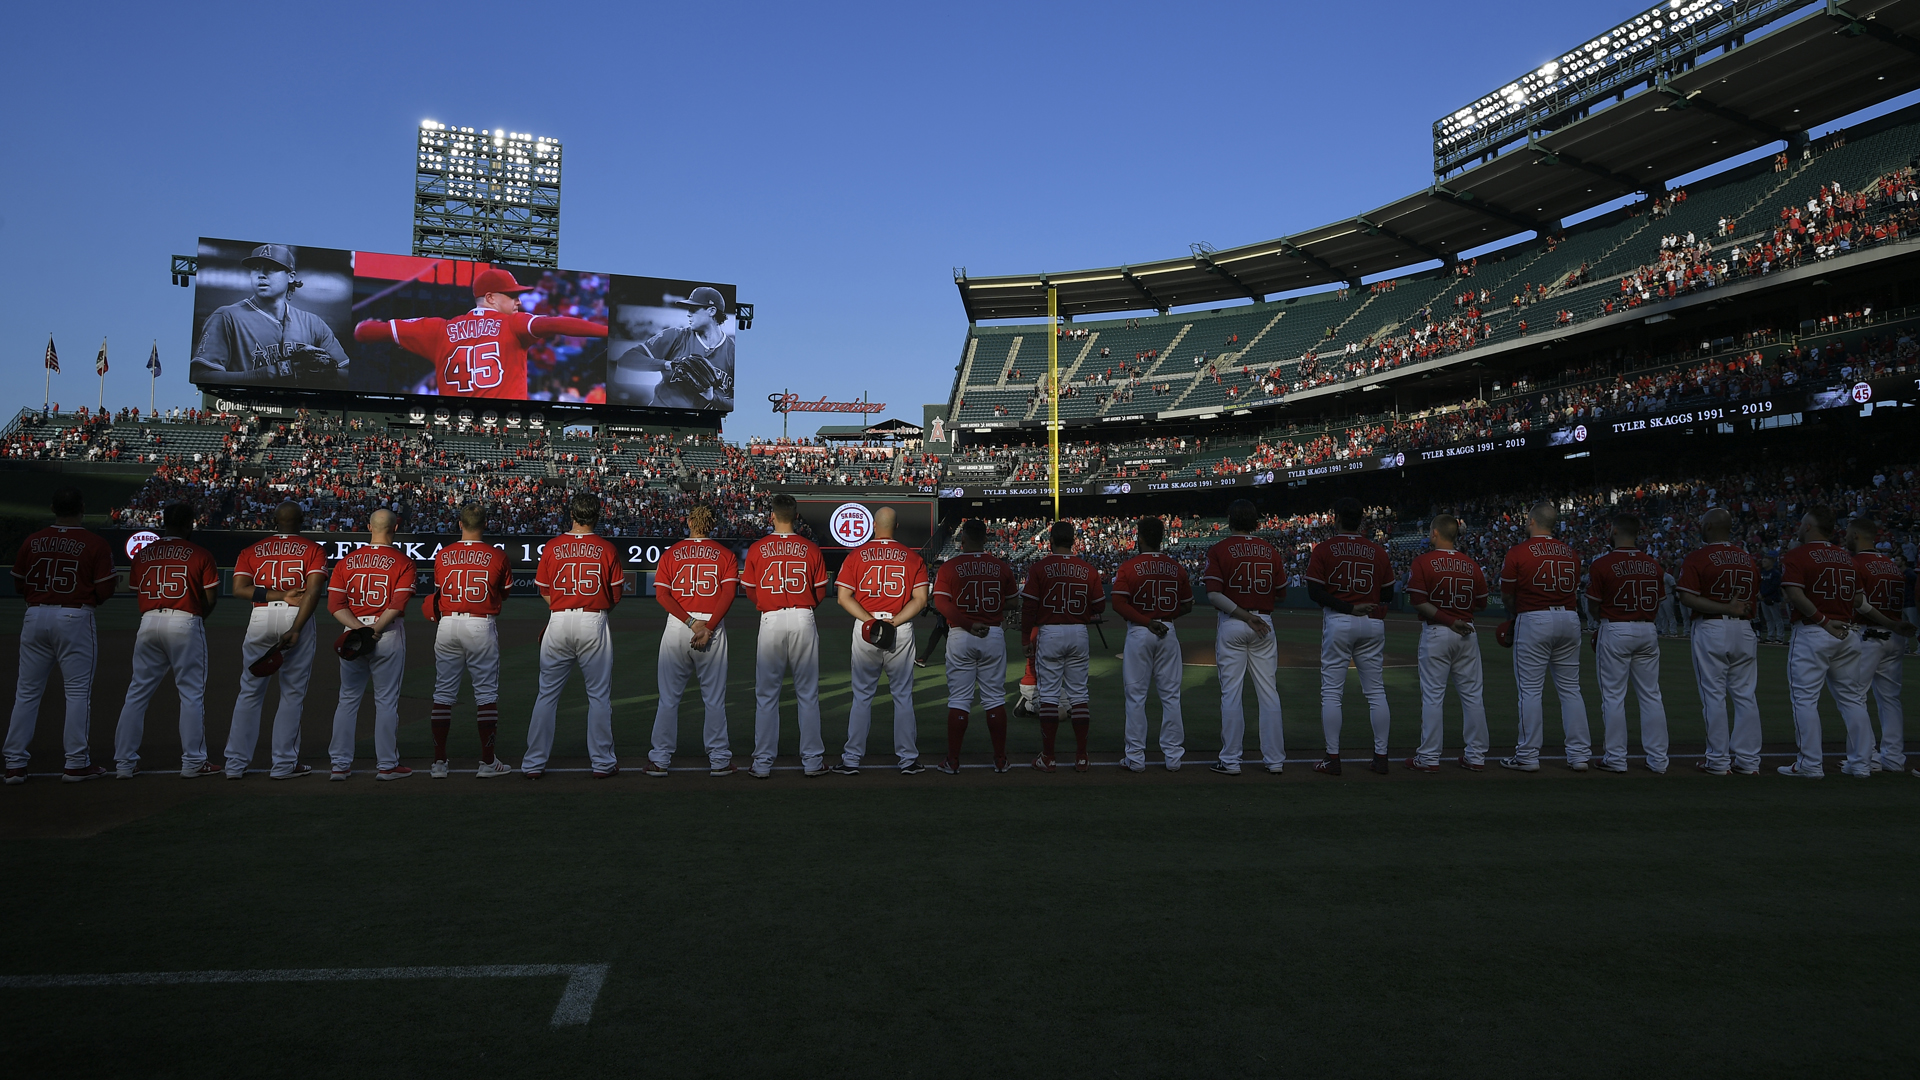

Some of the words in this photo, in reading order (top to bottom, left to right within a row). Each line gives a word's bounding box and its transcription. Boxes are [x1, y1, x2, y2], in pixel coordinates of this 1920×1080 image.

[447, 318, 502, 343] SKAGGS
[444, 341, 504, 392] 45
[769, 393, 886, 413] Budweiser
[1855, 389, 1869, 400] 45
[216, 398, 248, 413] Captain
[246, 399, 283, 415] Morgan
[1612, 421, 1647, 434] TYLER
[1650, 413, 1693, 429] SKAGGS
[1697, 408, 1724, 422] 1991
[1742, 401, 1773, 415] 2019
[1421, 449, 1445, 460] TYLER
[1446, 445, 1475, 456] SKAGGS
[1477, 442, 1495, 453] 1991
[1505, 437, 1526, 449] 2019
[1287, 469, 1307, 478] TYLER
[1307, 466, 1328, 476] SKAGGS
[1329, 463, 1342, 472] 1991
[1348, 461, 1363, 470] 2019
[918, 485, 933, 493] 7:02
[982, 488, 1009, 496] TYLER
[1148, 483, 1169, 491] TYLER
[1171, 481, 1197, 489] SKAGGS
[1199, 480, 1213, 488] 1991
[1220, 478, 1236, 486] 2019
[840, 512, 864, 520] SKAGGS
[839, 520, 864, 537] 45
[30, 537, 86, 557] SKAGGS
[139, 545, 193, 563] SKAGGS
[254, 541, 308, 558] SKAGGS
[553, 543, 603, 560] SKAGGS
[628, 544, 667, 563] 20
[673, 545, 720, 562] SKAGGS
[759, 541, 808, 559] SKAGGS
[859, 546, 907, 563] SKAGGS
[1228, 544, 1272, 560] SKAGGS
[1329, 542, 1376, 561] SKAGGS
[1528, 543, 1574, 558] SKAGGS
[346, 553, 396, 571] SKAGGS
[441, 548, 493, 567] SKAGGS
[1709, 550, 1752, 567] SKAGGS
[1809, 550, 1854, 567] SKAGGS
[26, 558, 78, 594] 45
[253, 560, 305, 591] 45
[955, 561, 1000, 578] SKAGGS
[1043, 562, 1089, 580] SKAGGS
[1133, 561, 1179, 578] SKAGGS
[1328, 560, 1375, 595] 45
[1430, 559, 1474, 577] SKAGGS
[1532, 560, 1576, 593] 45
[1611, 561, 1658, 577] SKAGGS
[139, 565, 188, 599] 45
[441, 569, 490, 603] 45
[553, 562, 602, 596] 45
[671, 564, 718, 597] 45
[760, 561, 807, 595] 45
[859, 565, 905, 598] 45
[1229, 561, 1273, 595] 45
[1710, 569, 1754, 601] 45
[1812, 567, 1856, 601] 45
[346, 573, 388, 608] 45
[956, 580, 1001, 613] 45
[1043, 582, 1089, 615] 45
[1133, 579, 1179, 612] 45
[1430, 576, 1474, 611] 45
[1613, 579, 1659, 612] 45
[1868, 579, 1905, 612] 45
